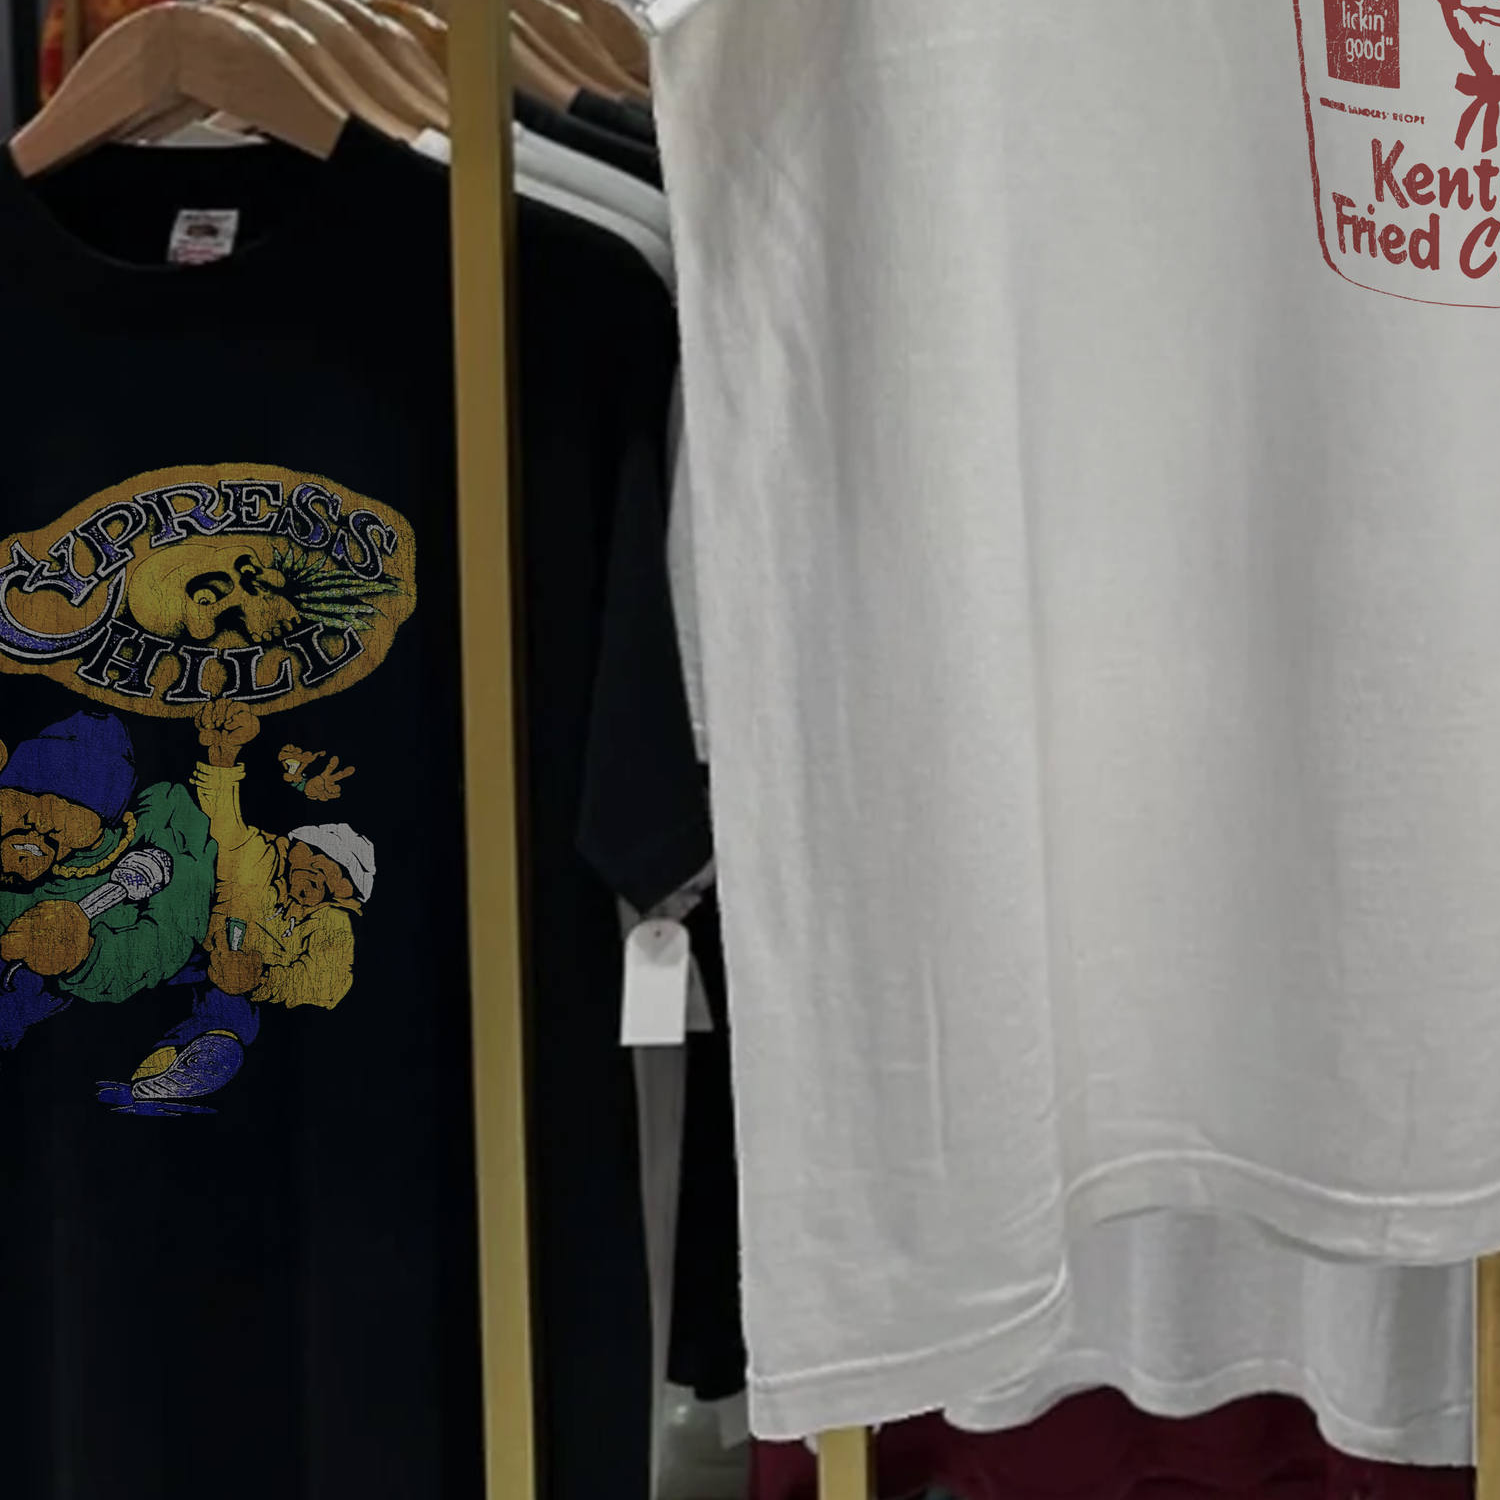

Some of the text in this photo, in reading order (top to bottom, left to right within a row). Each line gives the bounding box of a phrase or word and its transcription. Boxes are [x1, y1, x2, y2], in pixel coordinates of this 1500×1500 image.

[1342, 0, 1388, 32] lickin'
[1346, 35, 1394, 63] good"
[1331, 191, 1441, 272] Fried
[0, 479, 398, 659] CYPRESS
[77, 618, 365, 702] HILL
